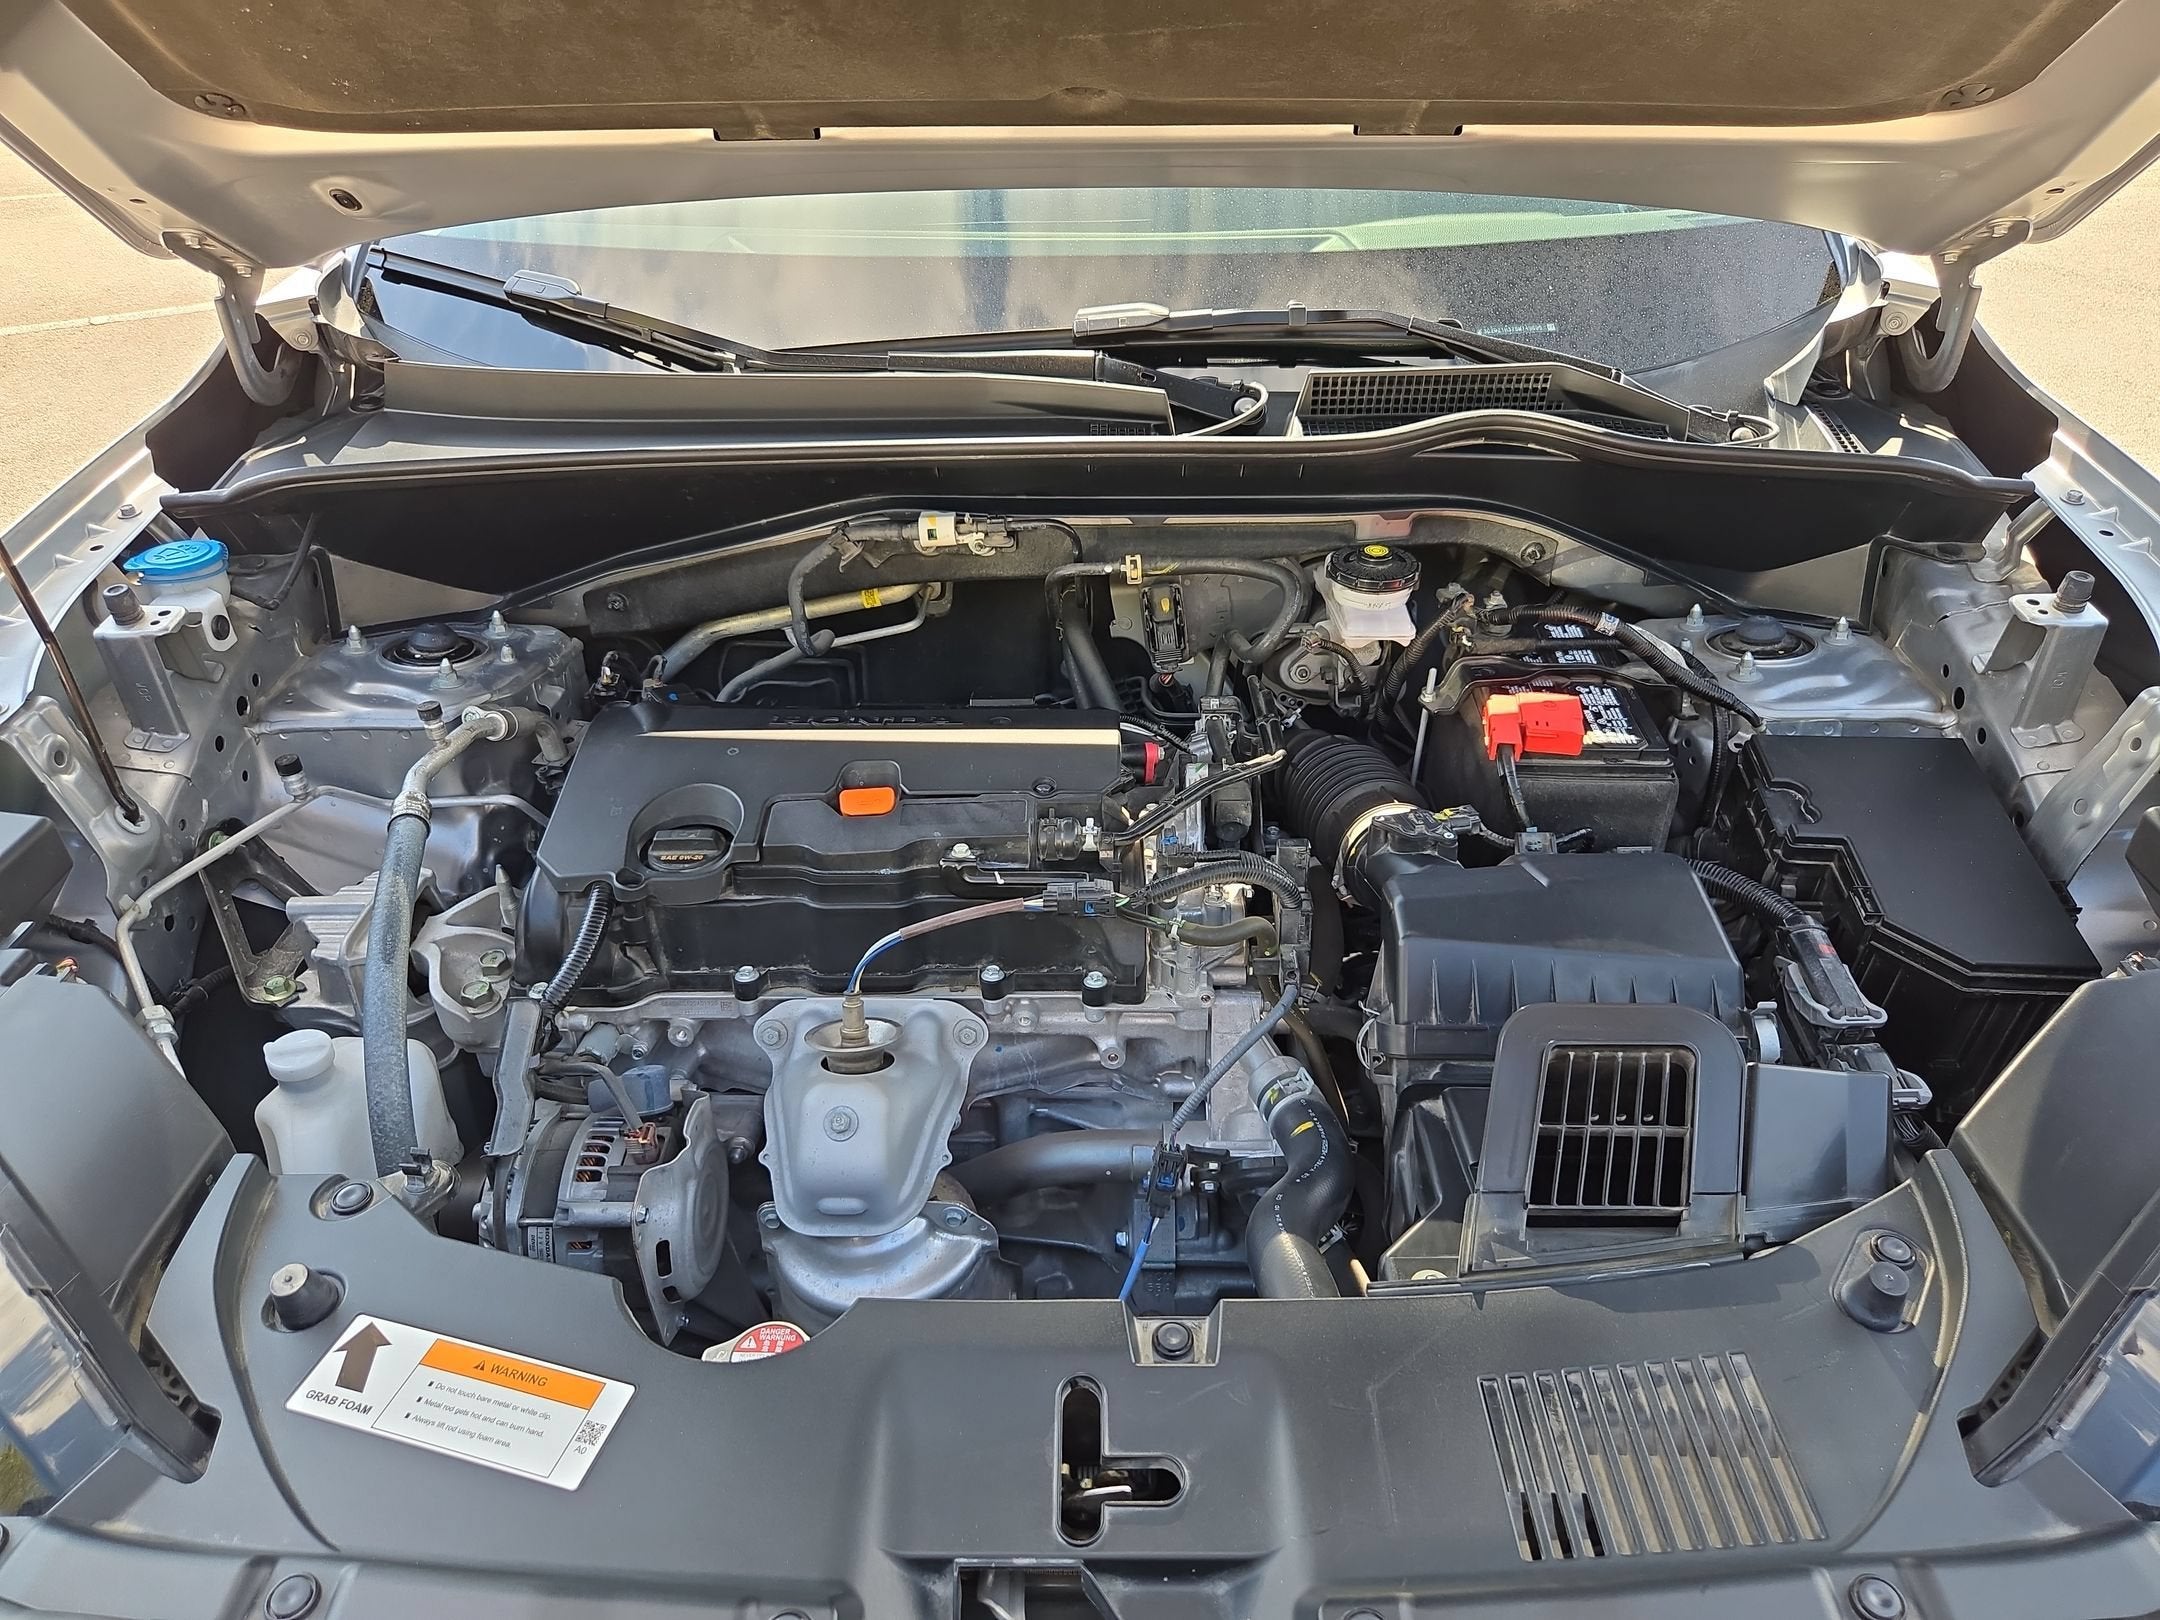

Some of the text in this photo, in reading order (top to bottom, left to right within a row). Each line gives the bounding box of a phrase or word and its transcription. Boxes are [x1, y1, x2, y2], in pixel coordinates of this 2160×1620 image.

[491, 1363, 549, 1387] WARNING
[306, 1390, 373, 1415] GRAB FOAM
[435, 1382, 445, 1390] Do
[446, 1385, 457, 1394] not
[458, 1388, 476, 1399] touch
[476, 1392, 492, 1403] bare
[493, 1397, 511, 1409] metal
[520, 1406, 538, 1416] white
[412, 1414, 436, 1427] Always
[436, 1420, 446, 1430] lift
[446, 1422, 458, 1432] rod
[458, 1427, 476, 1439] using
[476, 1431, 494, 1443] foam
[424, 1398, 443, 1408] Metal
[442, 1403, 455, 1412] rod
[455, 1407, 470, 1416] gets
[470, 1410, 482, 1420] hot
[482, 1414, 496, 1424] and
[496, 1419, 509, 1427] can
[510, 1420, 526, 1432] burn
